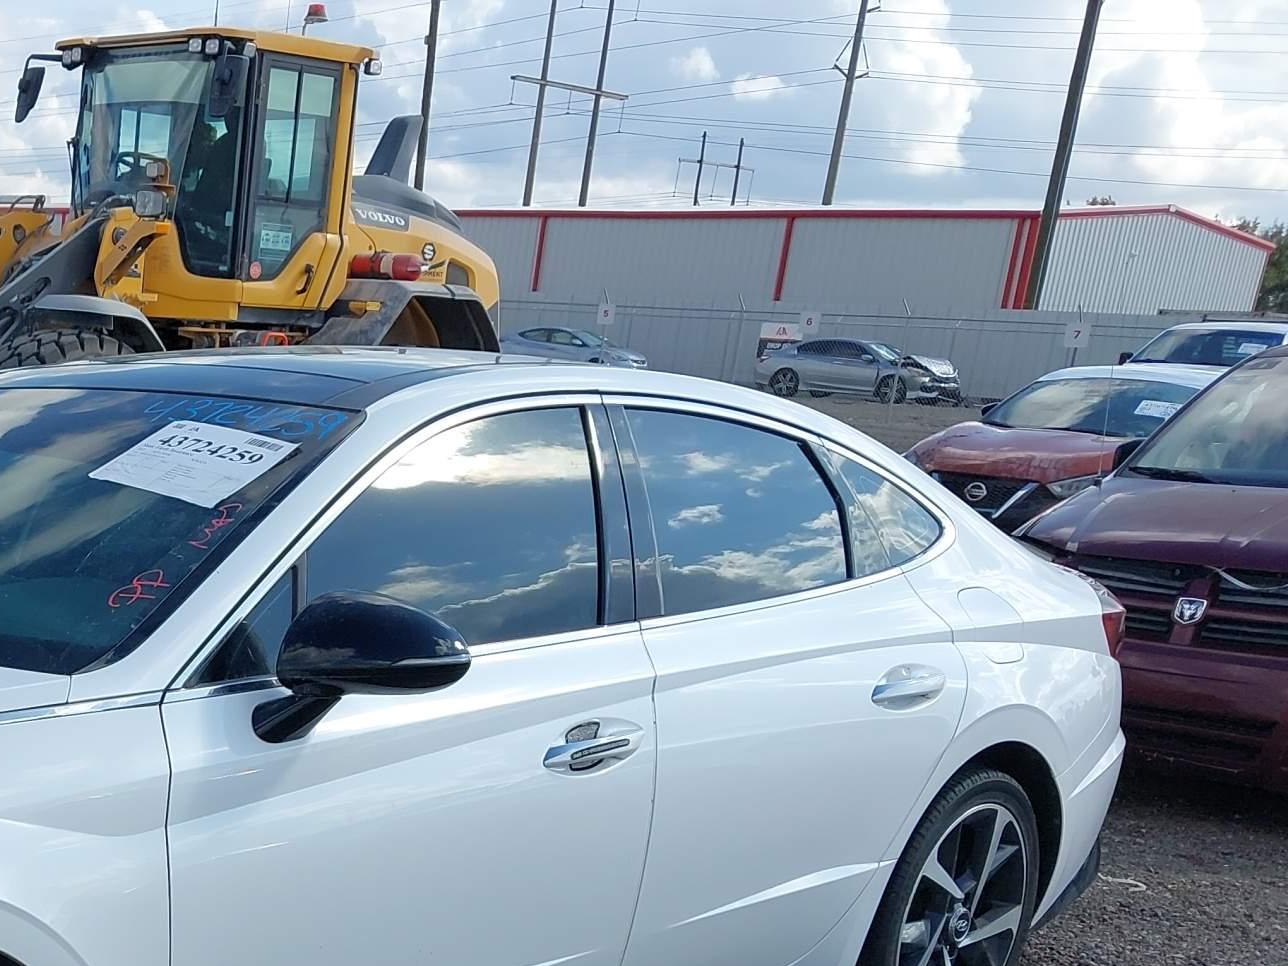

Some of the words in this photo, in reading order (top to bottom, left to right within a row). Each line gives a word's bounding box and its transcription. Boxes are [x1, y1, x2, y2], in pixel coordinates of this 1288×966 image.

[355, 208, 406, 226] VOLVO
[603, 309, 609, 318] 5
[806, 317, 813, 326] 6
[1073, 330, 1081, 340] 7
[158, 434, 265, 465] 43724259
